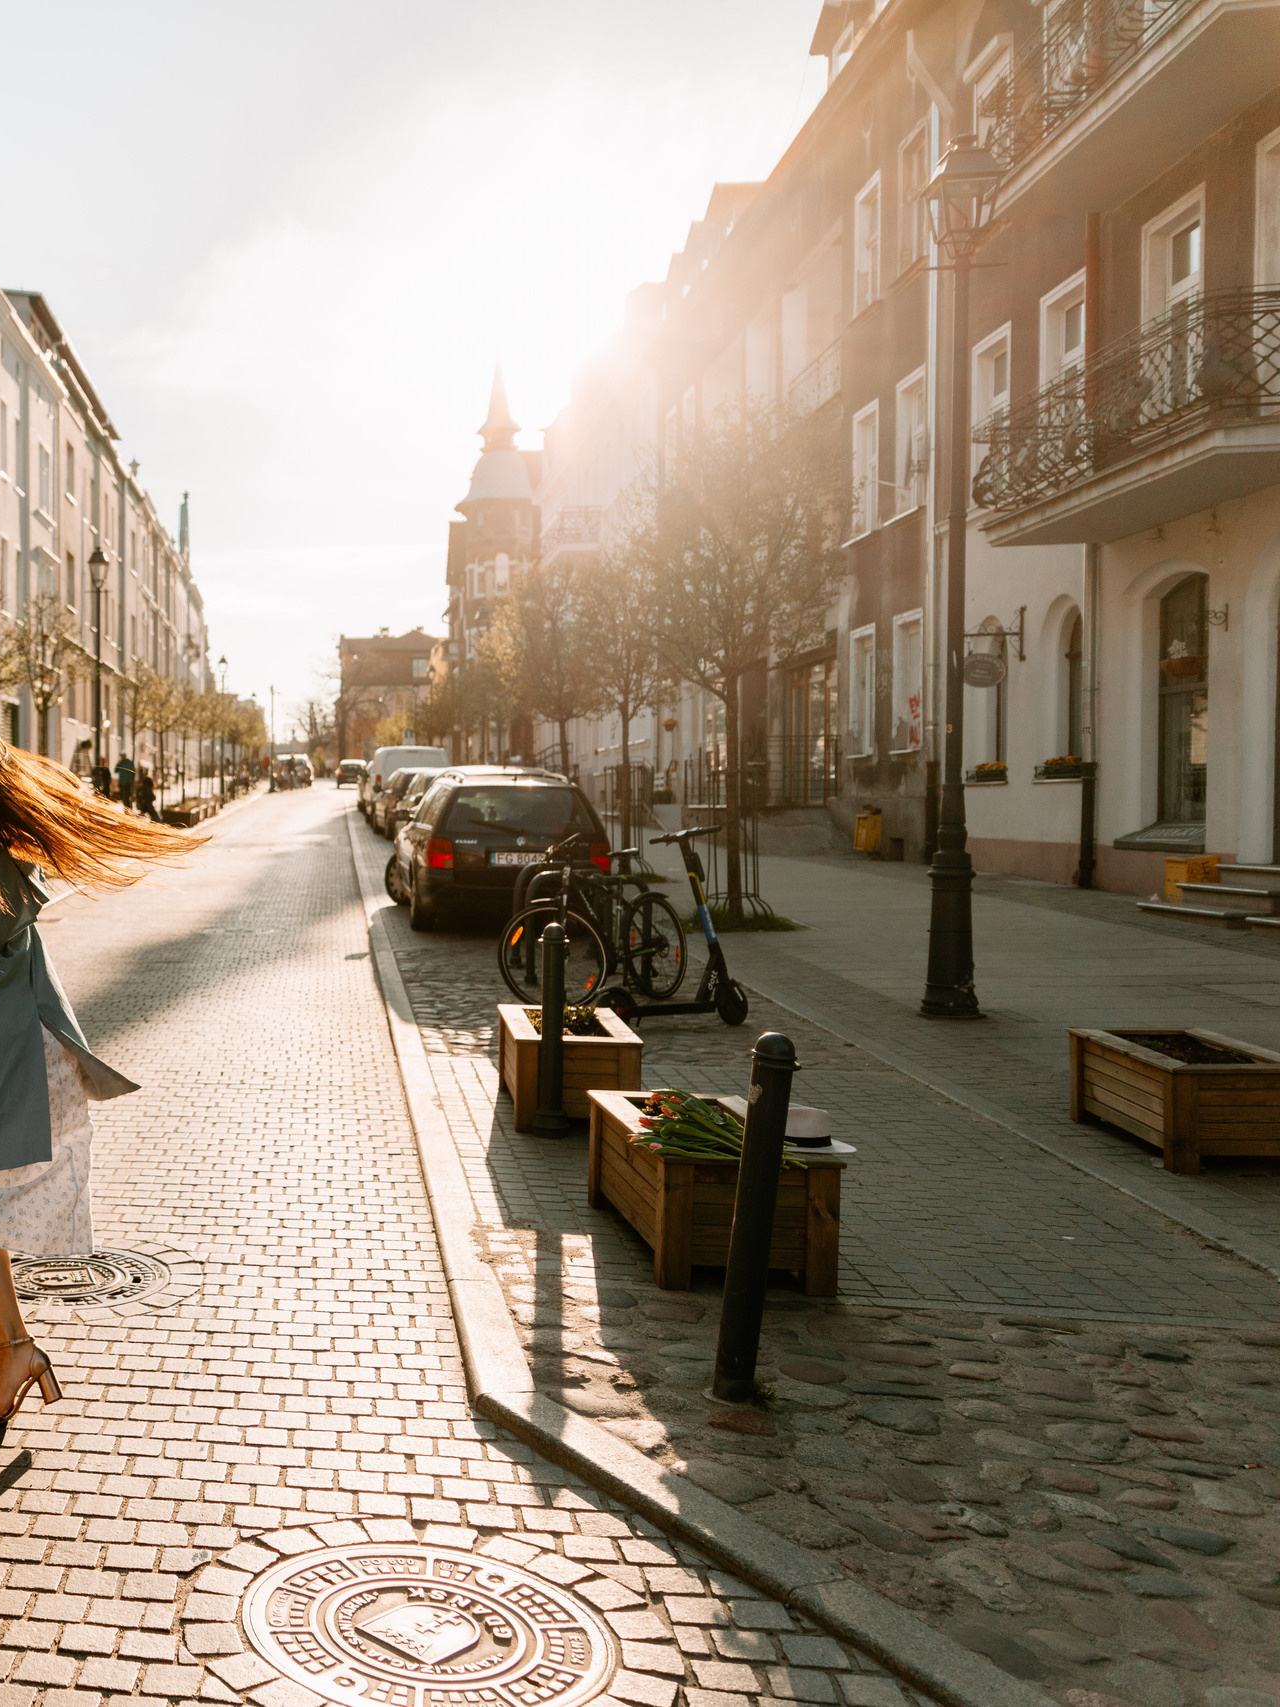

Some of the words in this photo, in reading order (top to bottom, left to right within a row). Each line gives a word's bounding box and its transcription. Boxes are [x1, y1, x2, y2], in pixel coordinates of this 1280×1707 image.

[708, 969, 718, 990] dott
[338, 1592, 376, 1647] SANITARNA
[368, 1649, 502, 1674] KANALIZACJA
